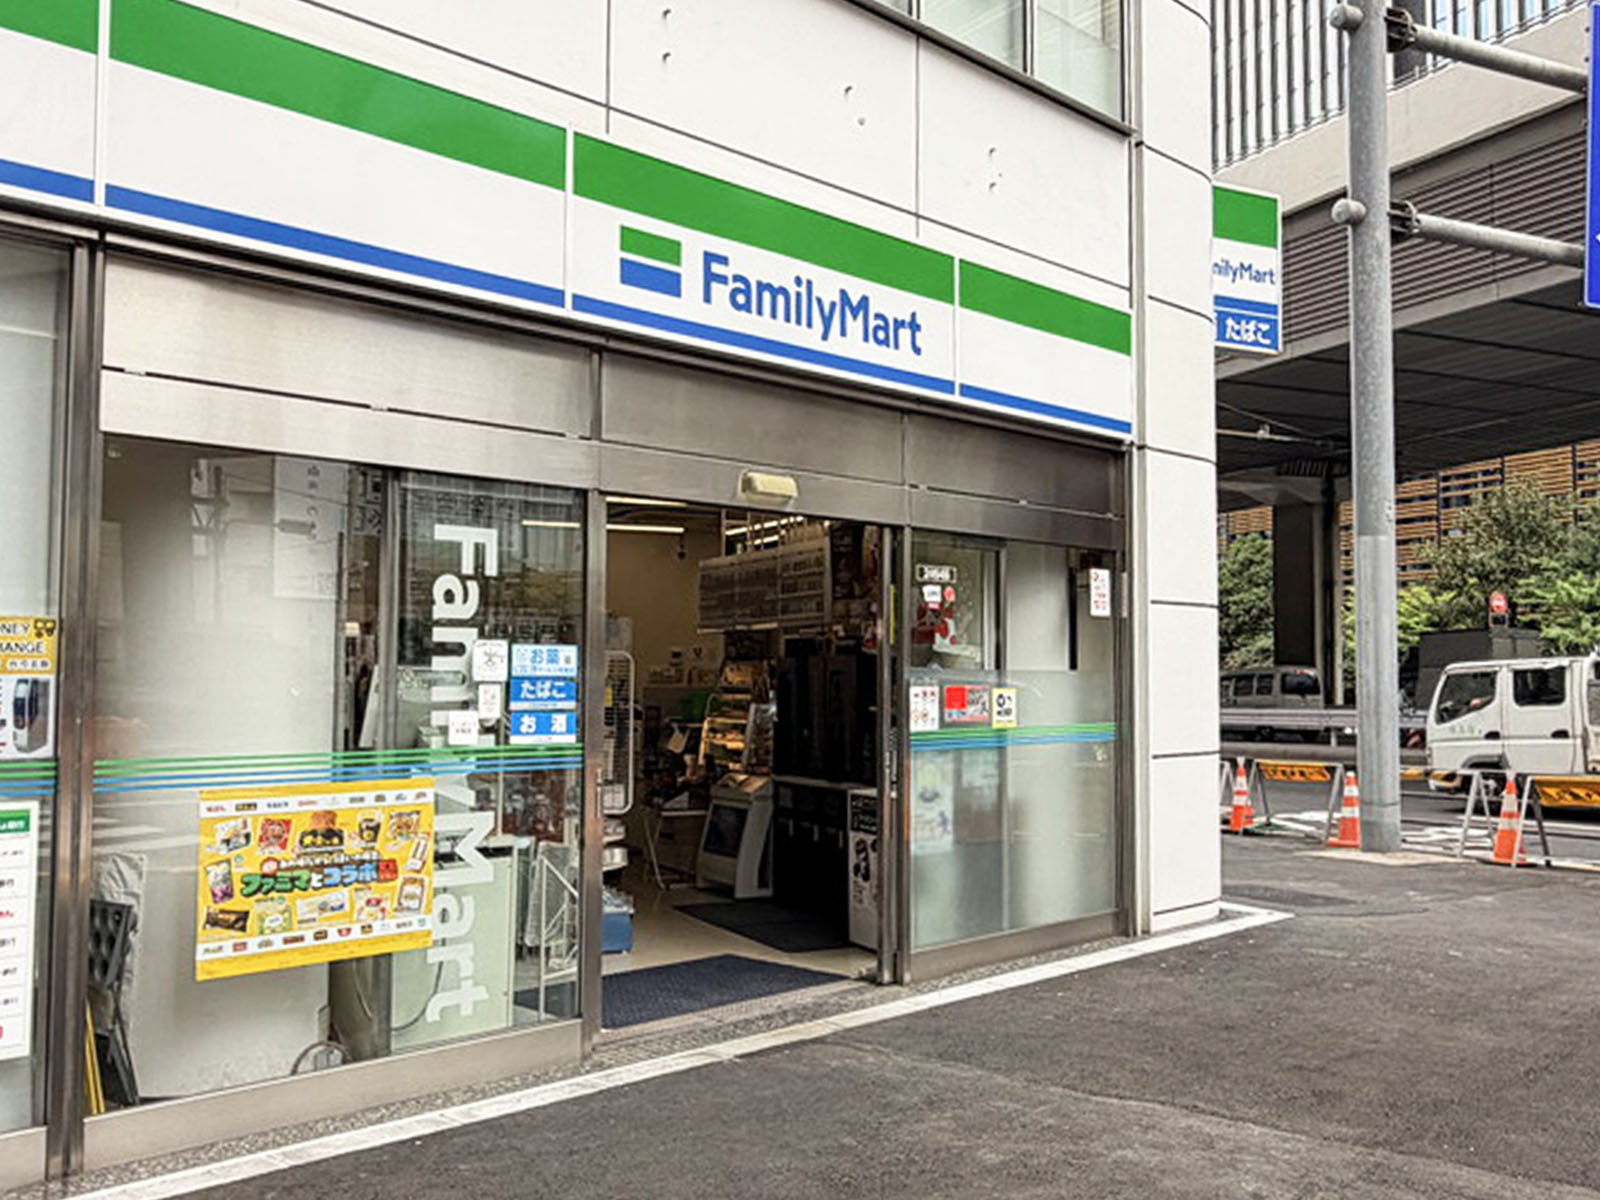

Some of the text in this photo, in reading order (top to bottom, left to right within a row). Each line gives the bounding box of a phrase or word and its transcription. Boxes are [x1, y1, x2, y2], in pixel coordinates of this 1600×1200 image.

[703, 250, 921, 356] FamilyMart
[1225, 317, 1272, 345] たばこ
[520, 680, 567, 699] たばこ
